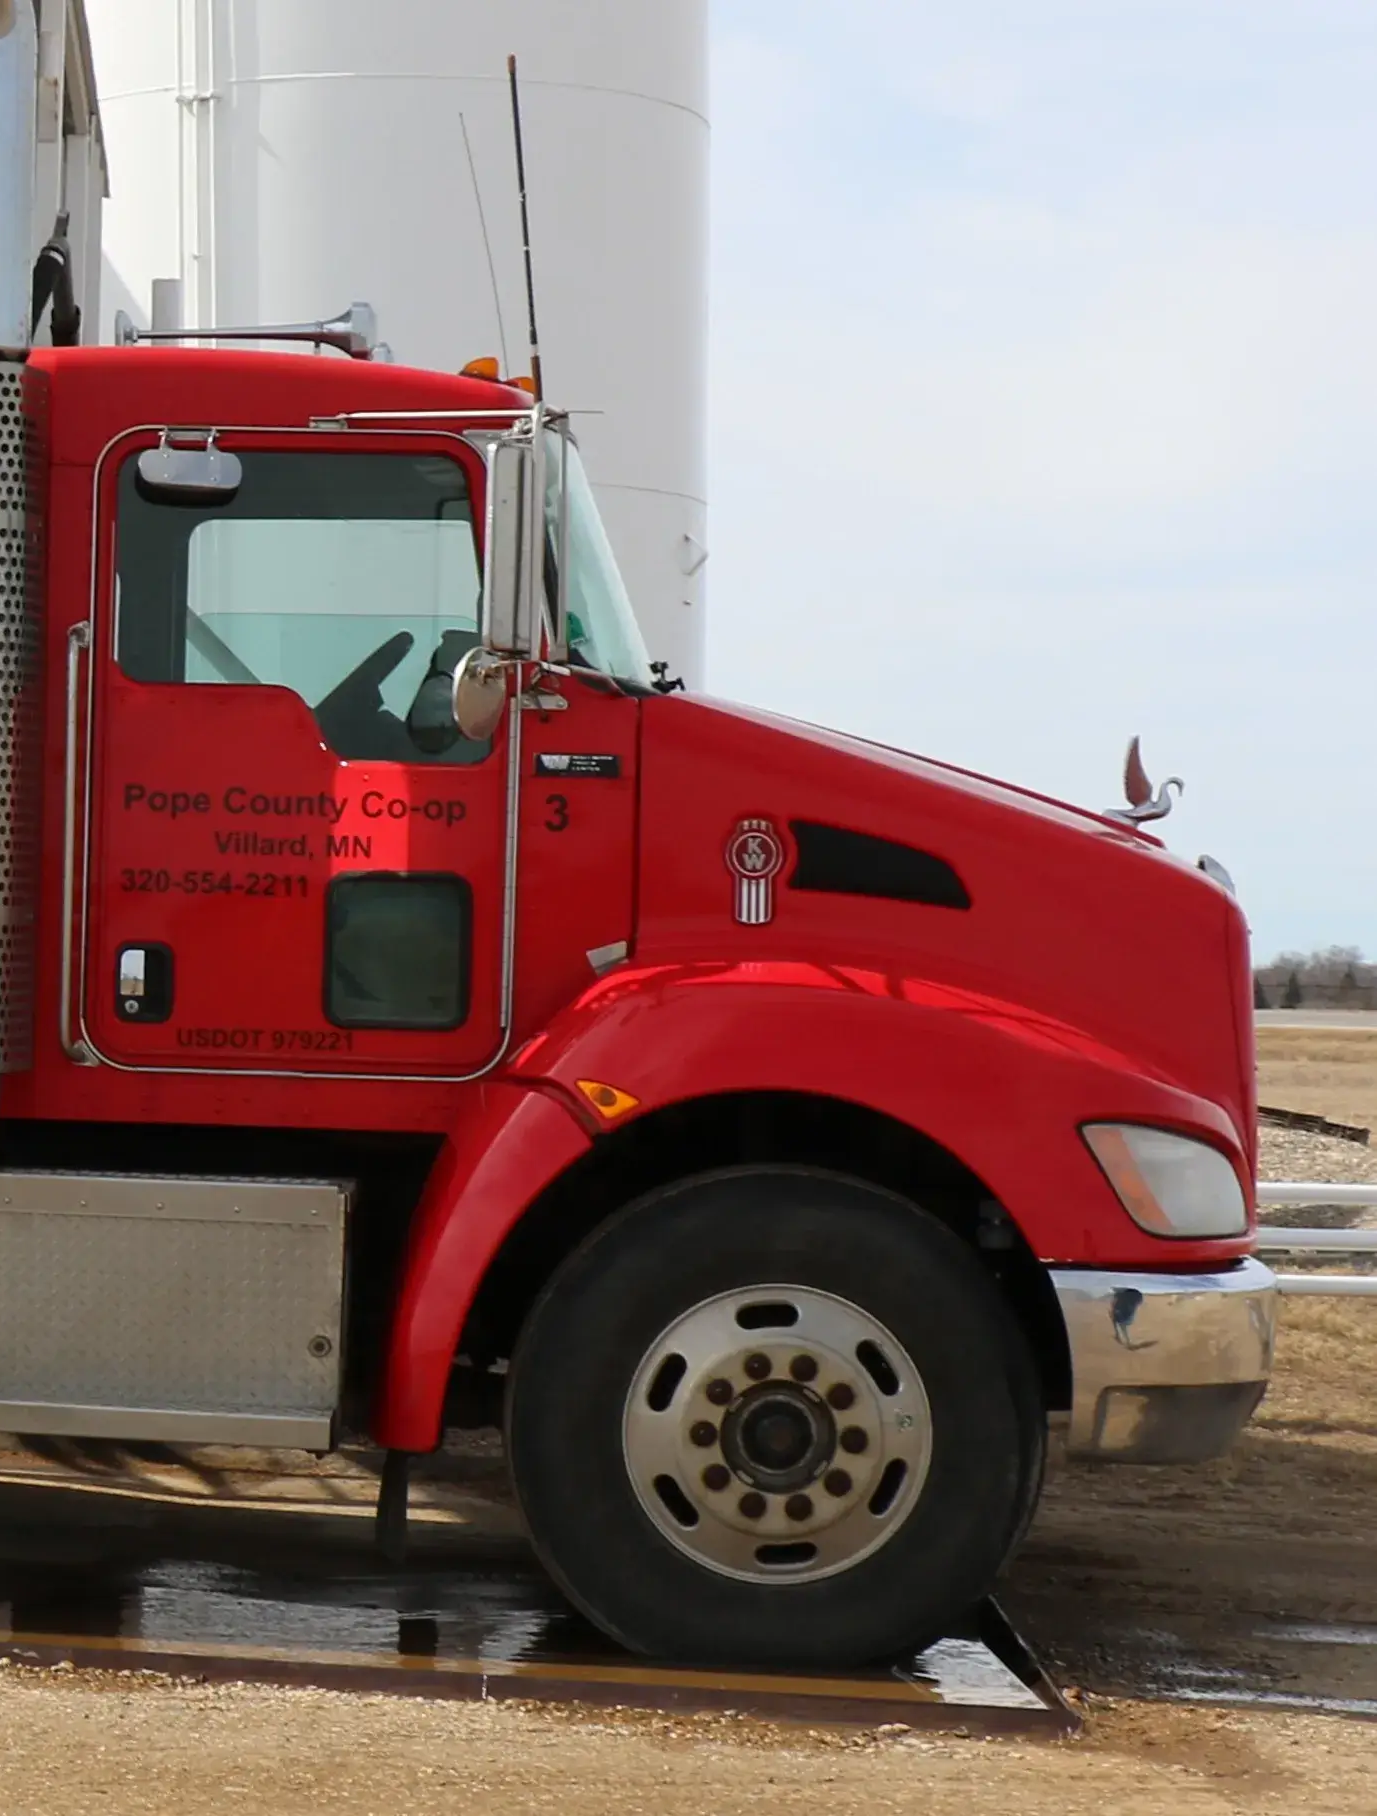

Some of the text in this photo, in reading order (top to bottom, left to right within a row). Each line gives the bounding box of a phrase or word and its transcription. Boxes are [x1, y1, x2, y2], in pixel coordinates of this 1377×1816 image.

[124, 783, 467, 828] Pope County Co-op
[545, 794, 569, 832] 3
[214, 831, 372, 860] Villard, MN
[121, 868, 309, 898] 320-554-2211
[176, 1028, 354, 1052] USDOT 979221
